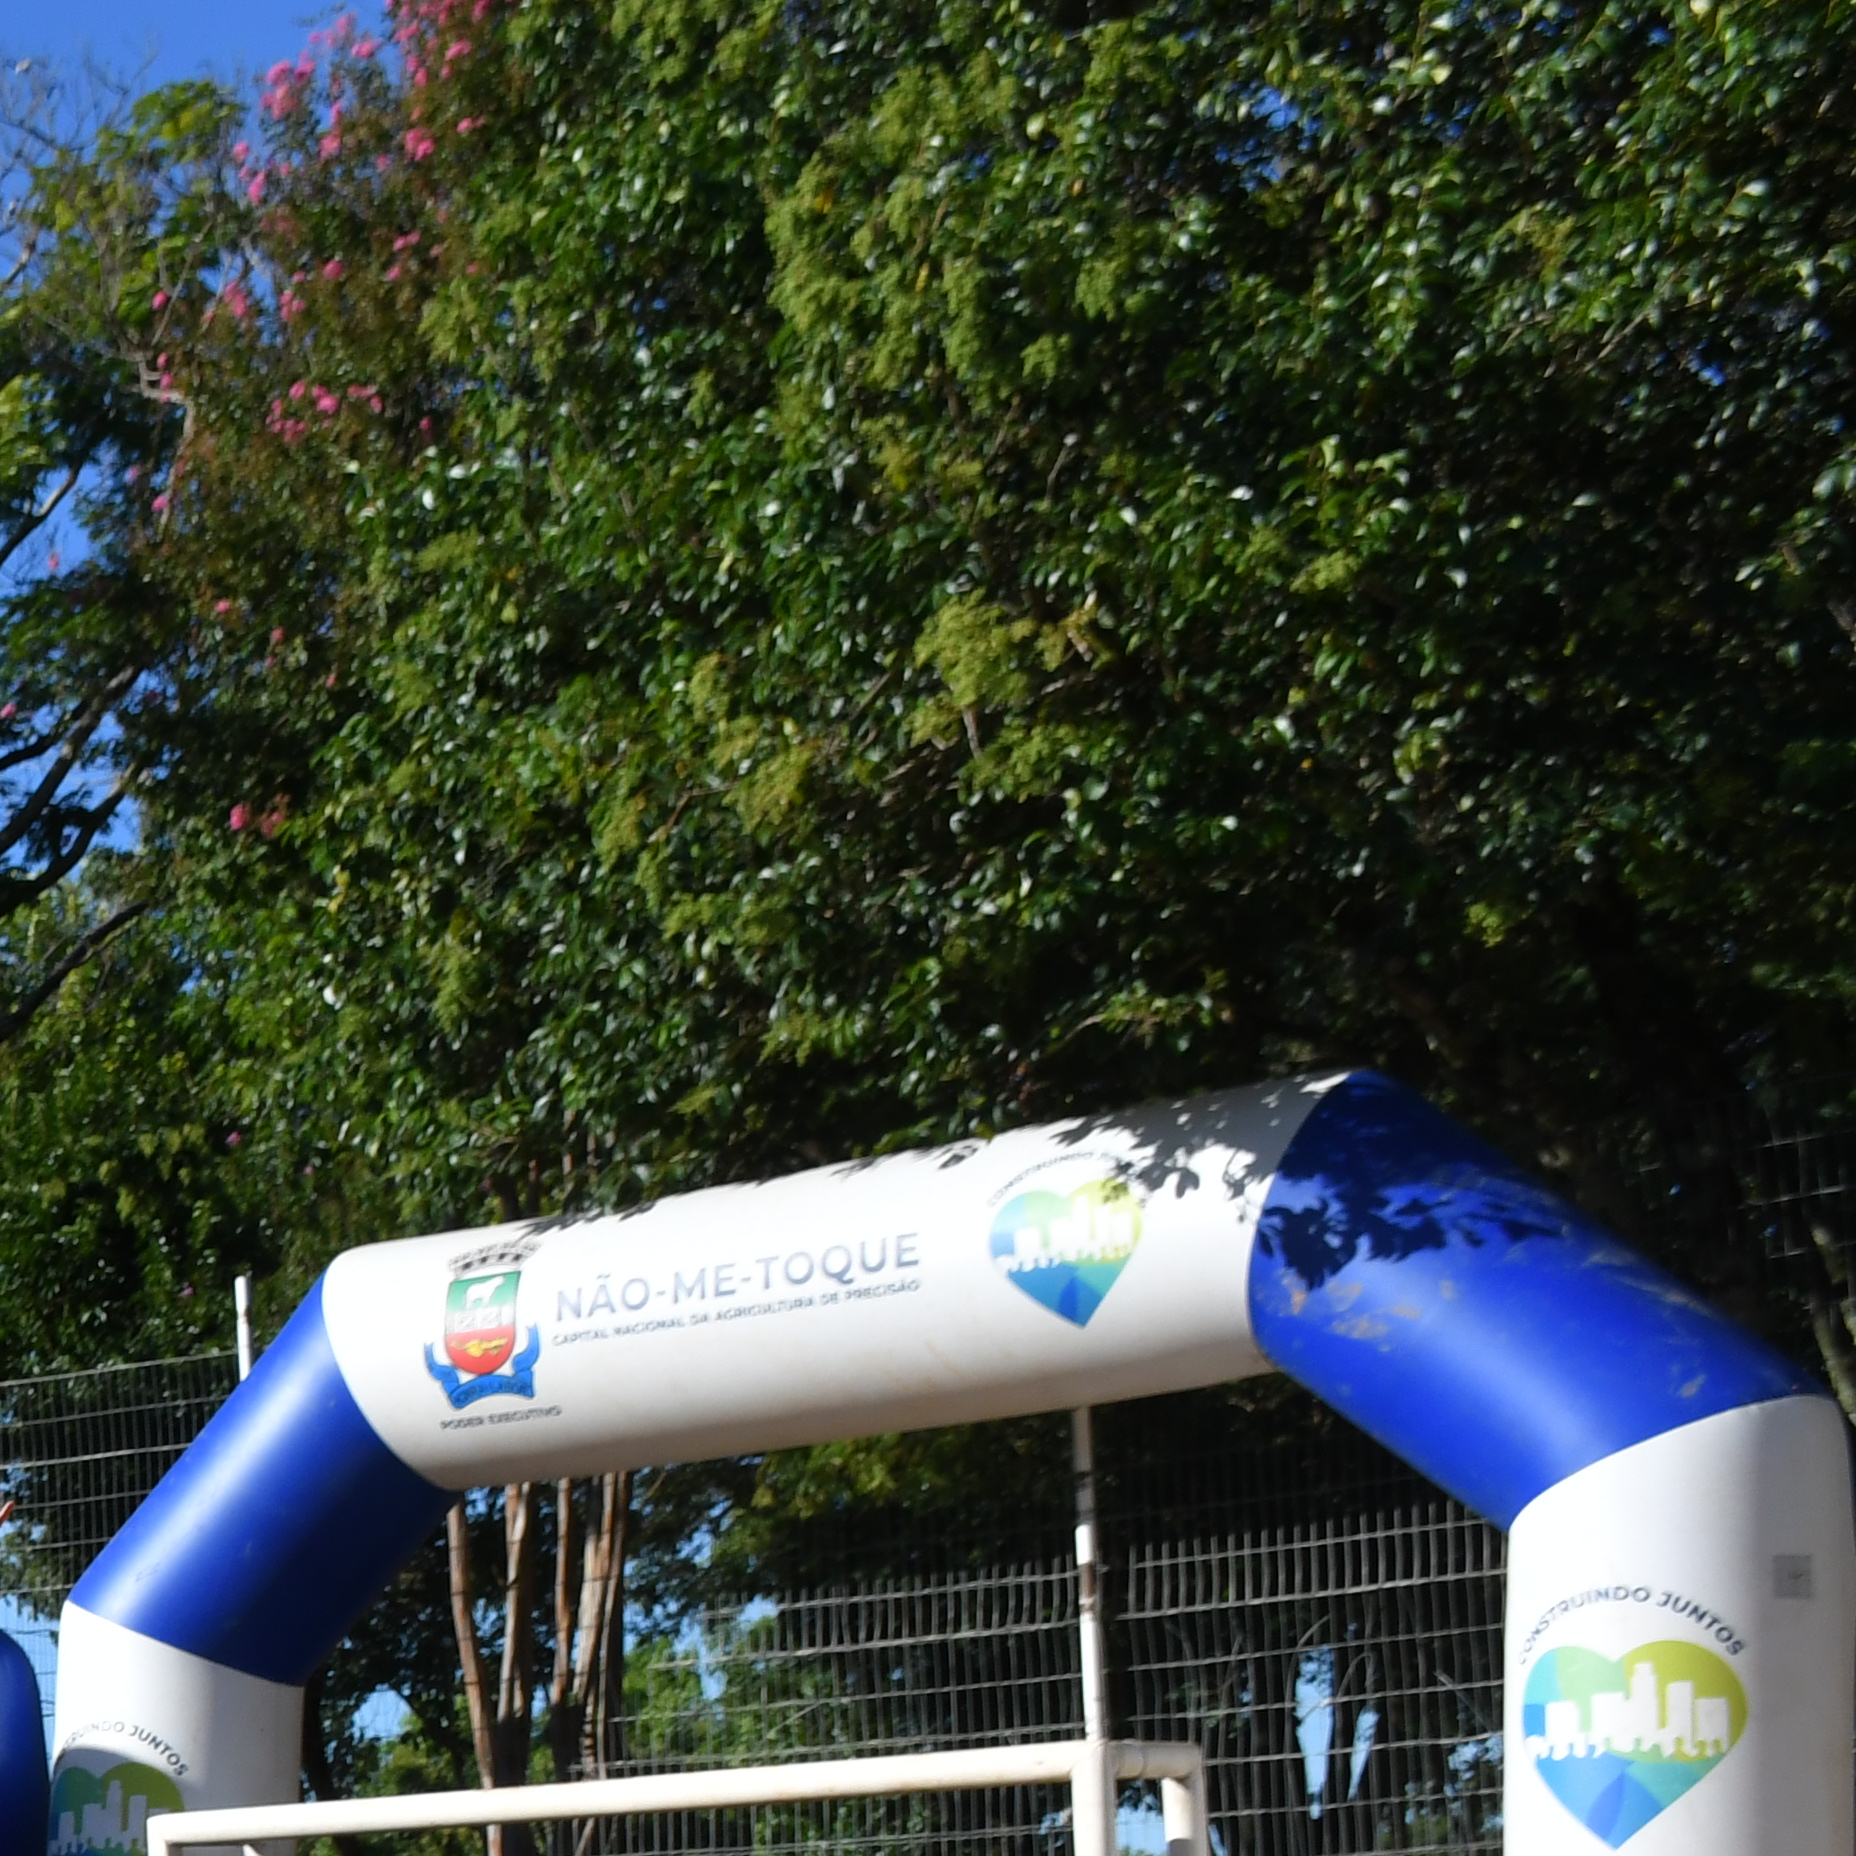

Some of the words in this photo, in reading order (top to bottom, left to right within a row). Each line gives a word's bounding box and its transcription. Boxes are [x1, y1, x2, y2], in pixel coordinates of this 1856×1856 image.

[553, 1327, 608, 1347] CAPITAL
[613, 1317, 686, 1338] NACIONAL
[714, 1296, 814, 1322] AGRICULTURA
[818, 1291, 840, 1308] DE
[844, 1278, 922, 1302] PRECISÃO
[555, 1232, 920, 1322] NÃO-ME-TOQUE
[1518, 1585, 1651, 1665] CONSTRUINDO
[1656, 1590, 1747, 1657] JUNTOS
[129, 1724, 189, 1776] JUNTOS
